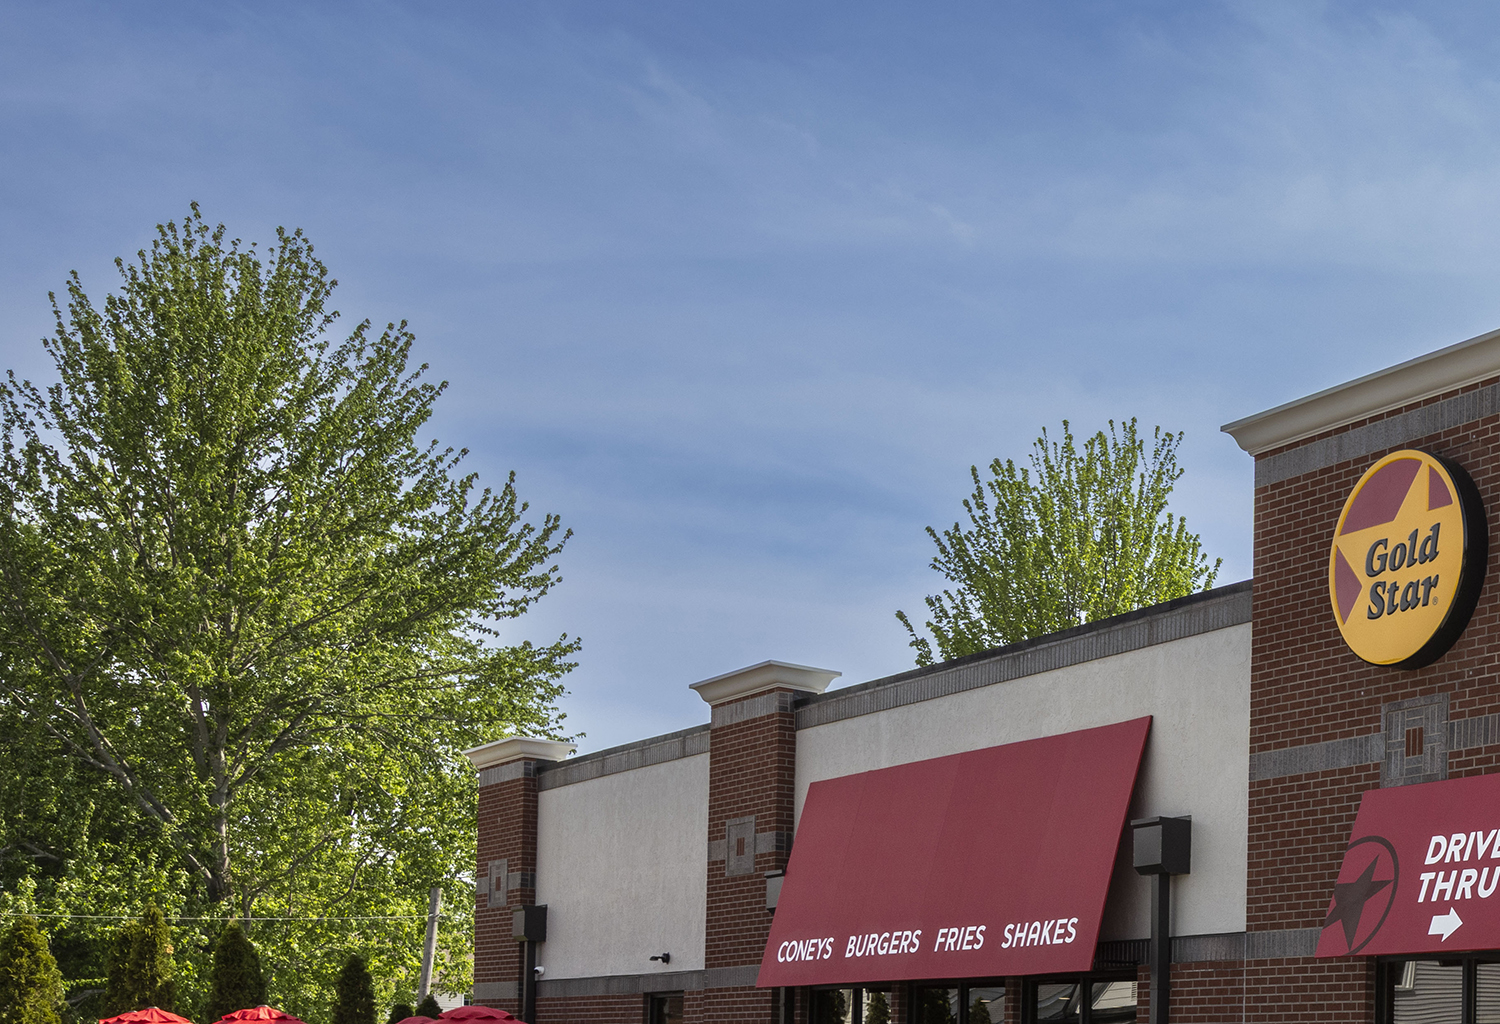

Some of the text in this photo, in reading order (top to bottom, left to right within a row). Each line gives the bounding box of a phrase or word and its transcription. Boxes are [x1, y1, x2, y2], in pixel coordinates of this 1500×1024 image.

[1365, 522, 1441, 577] Gold
[1366, 574, 1440, 620] Star
[776, 917, 1079, 963] CONEYS BURGERS FRIES SHAKES
